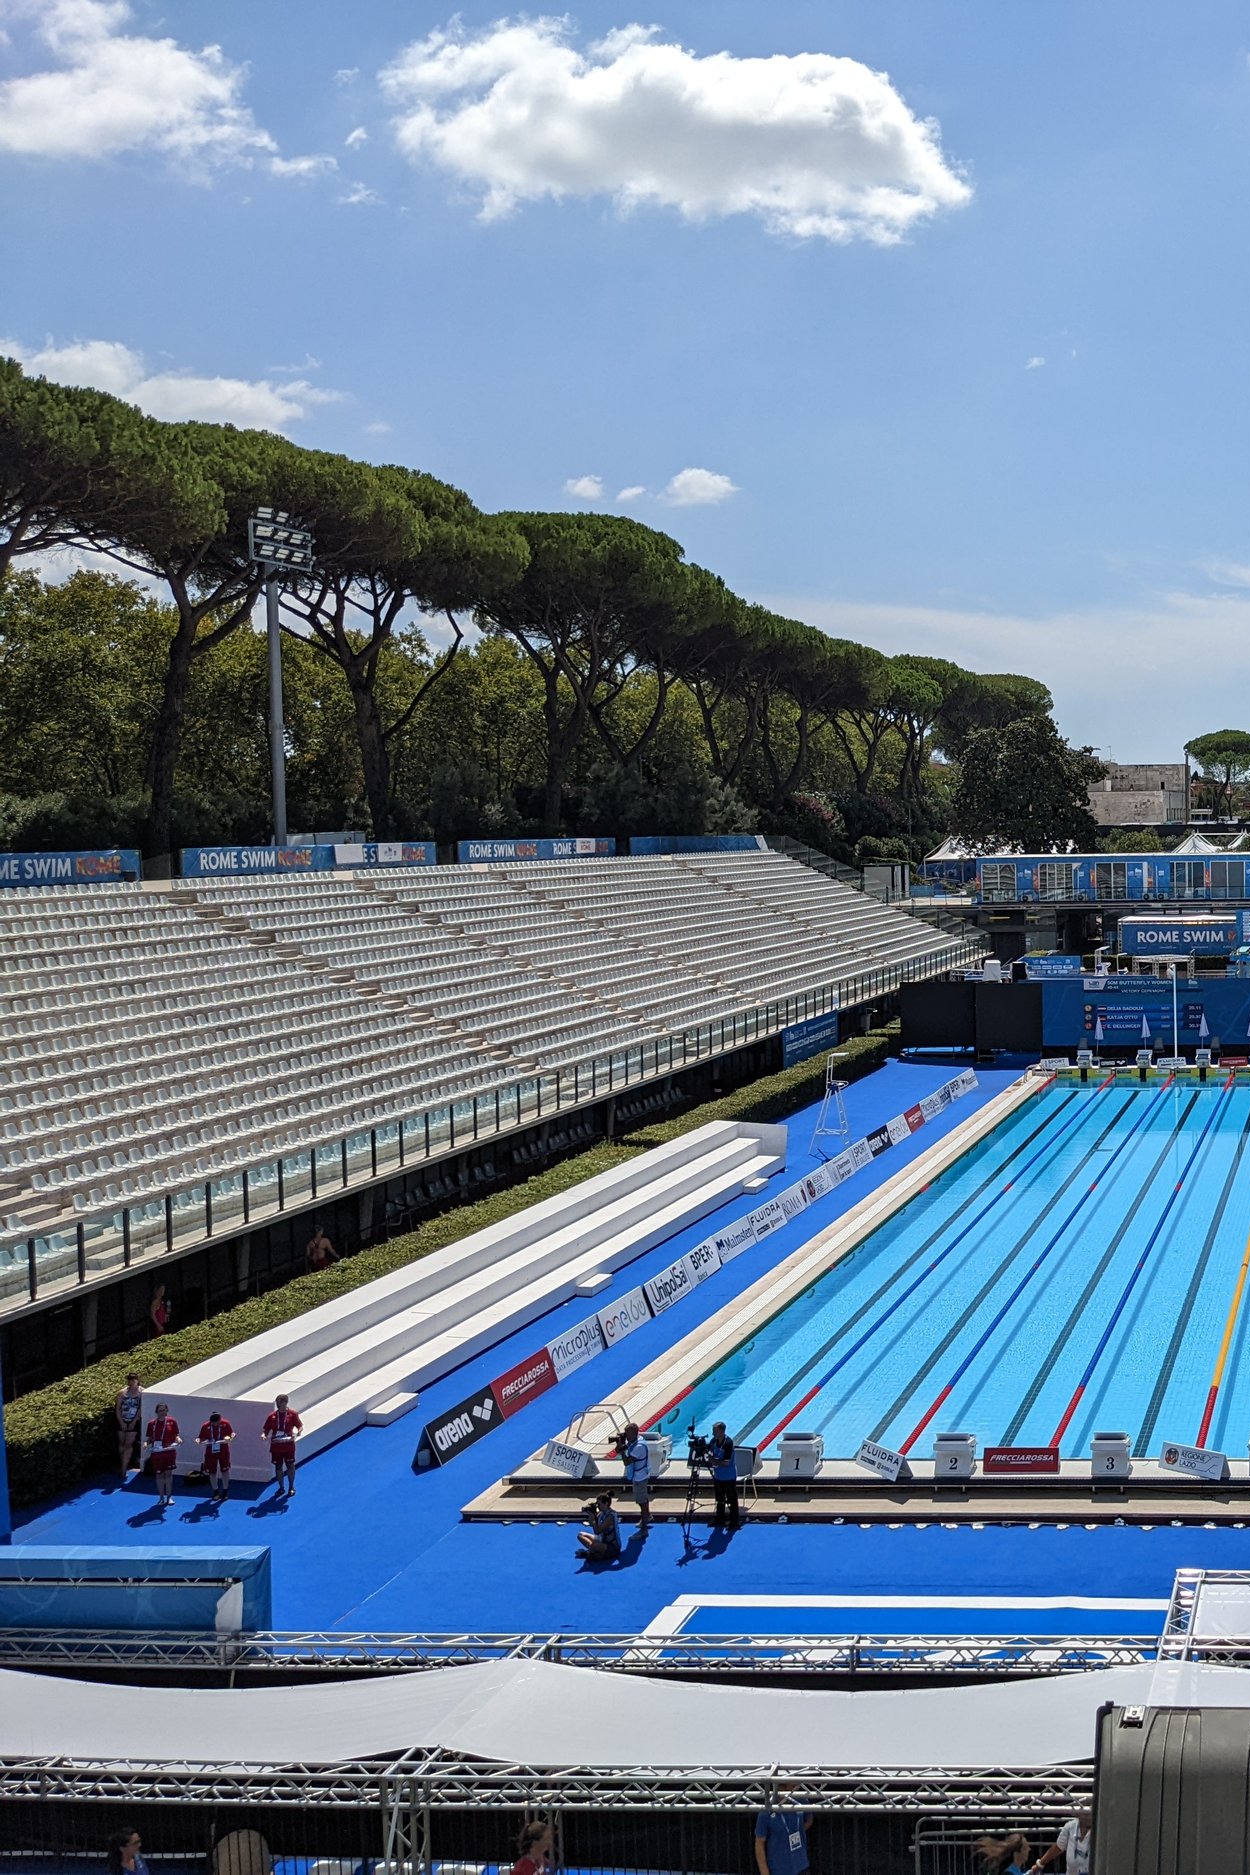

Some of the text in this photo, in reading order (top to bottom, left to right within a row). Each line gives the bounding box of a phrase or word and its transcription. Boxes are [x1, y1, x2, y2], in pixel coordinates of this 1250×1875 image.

[469, 843, 492, 858] ROME
[493, 843, 515, 857] SWIM
[553, 842, 572, 855] ROME
[0, 855, 122, 880] ME SWIM ROME
[200, 849, 312, 870] ROME SWIM ROME
[1137, 931, 1179, 943] ROME
[1183, 930, 1224, 942] SWIM
[750, 1201, 781, 1227] FLUIDRA
[782, 1195, 803, 1217] ROMA
[725, 1227, 752, 1252] Malmsten
[605, 1303, 632, 1338] enel
[501, 1359, 550, 1400] FRECCIAROSSA
[434, 1411, 475, 1451] arena
[555, 1445, 583, 1464] SPORT
[794, 1457, 800, 1470] 1
[861, 1443, 899, 1466] FLUIDRA
[949, 1457, 958, 1470] 2
[989, 1454, 1055, 1463] FRECCIAROSSA
[1106, 1457, 1115, 1470] 3
[1181, 1449, 1206, 1461] REGIONE
[552, 1457, 580, 1474] E SALUTE
[1180, 1459, 1197, 1469] LAZIO
